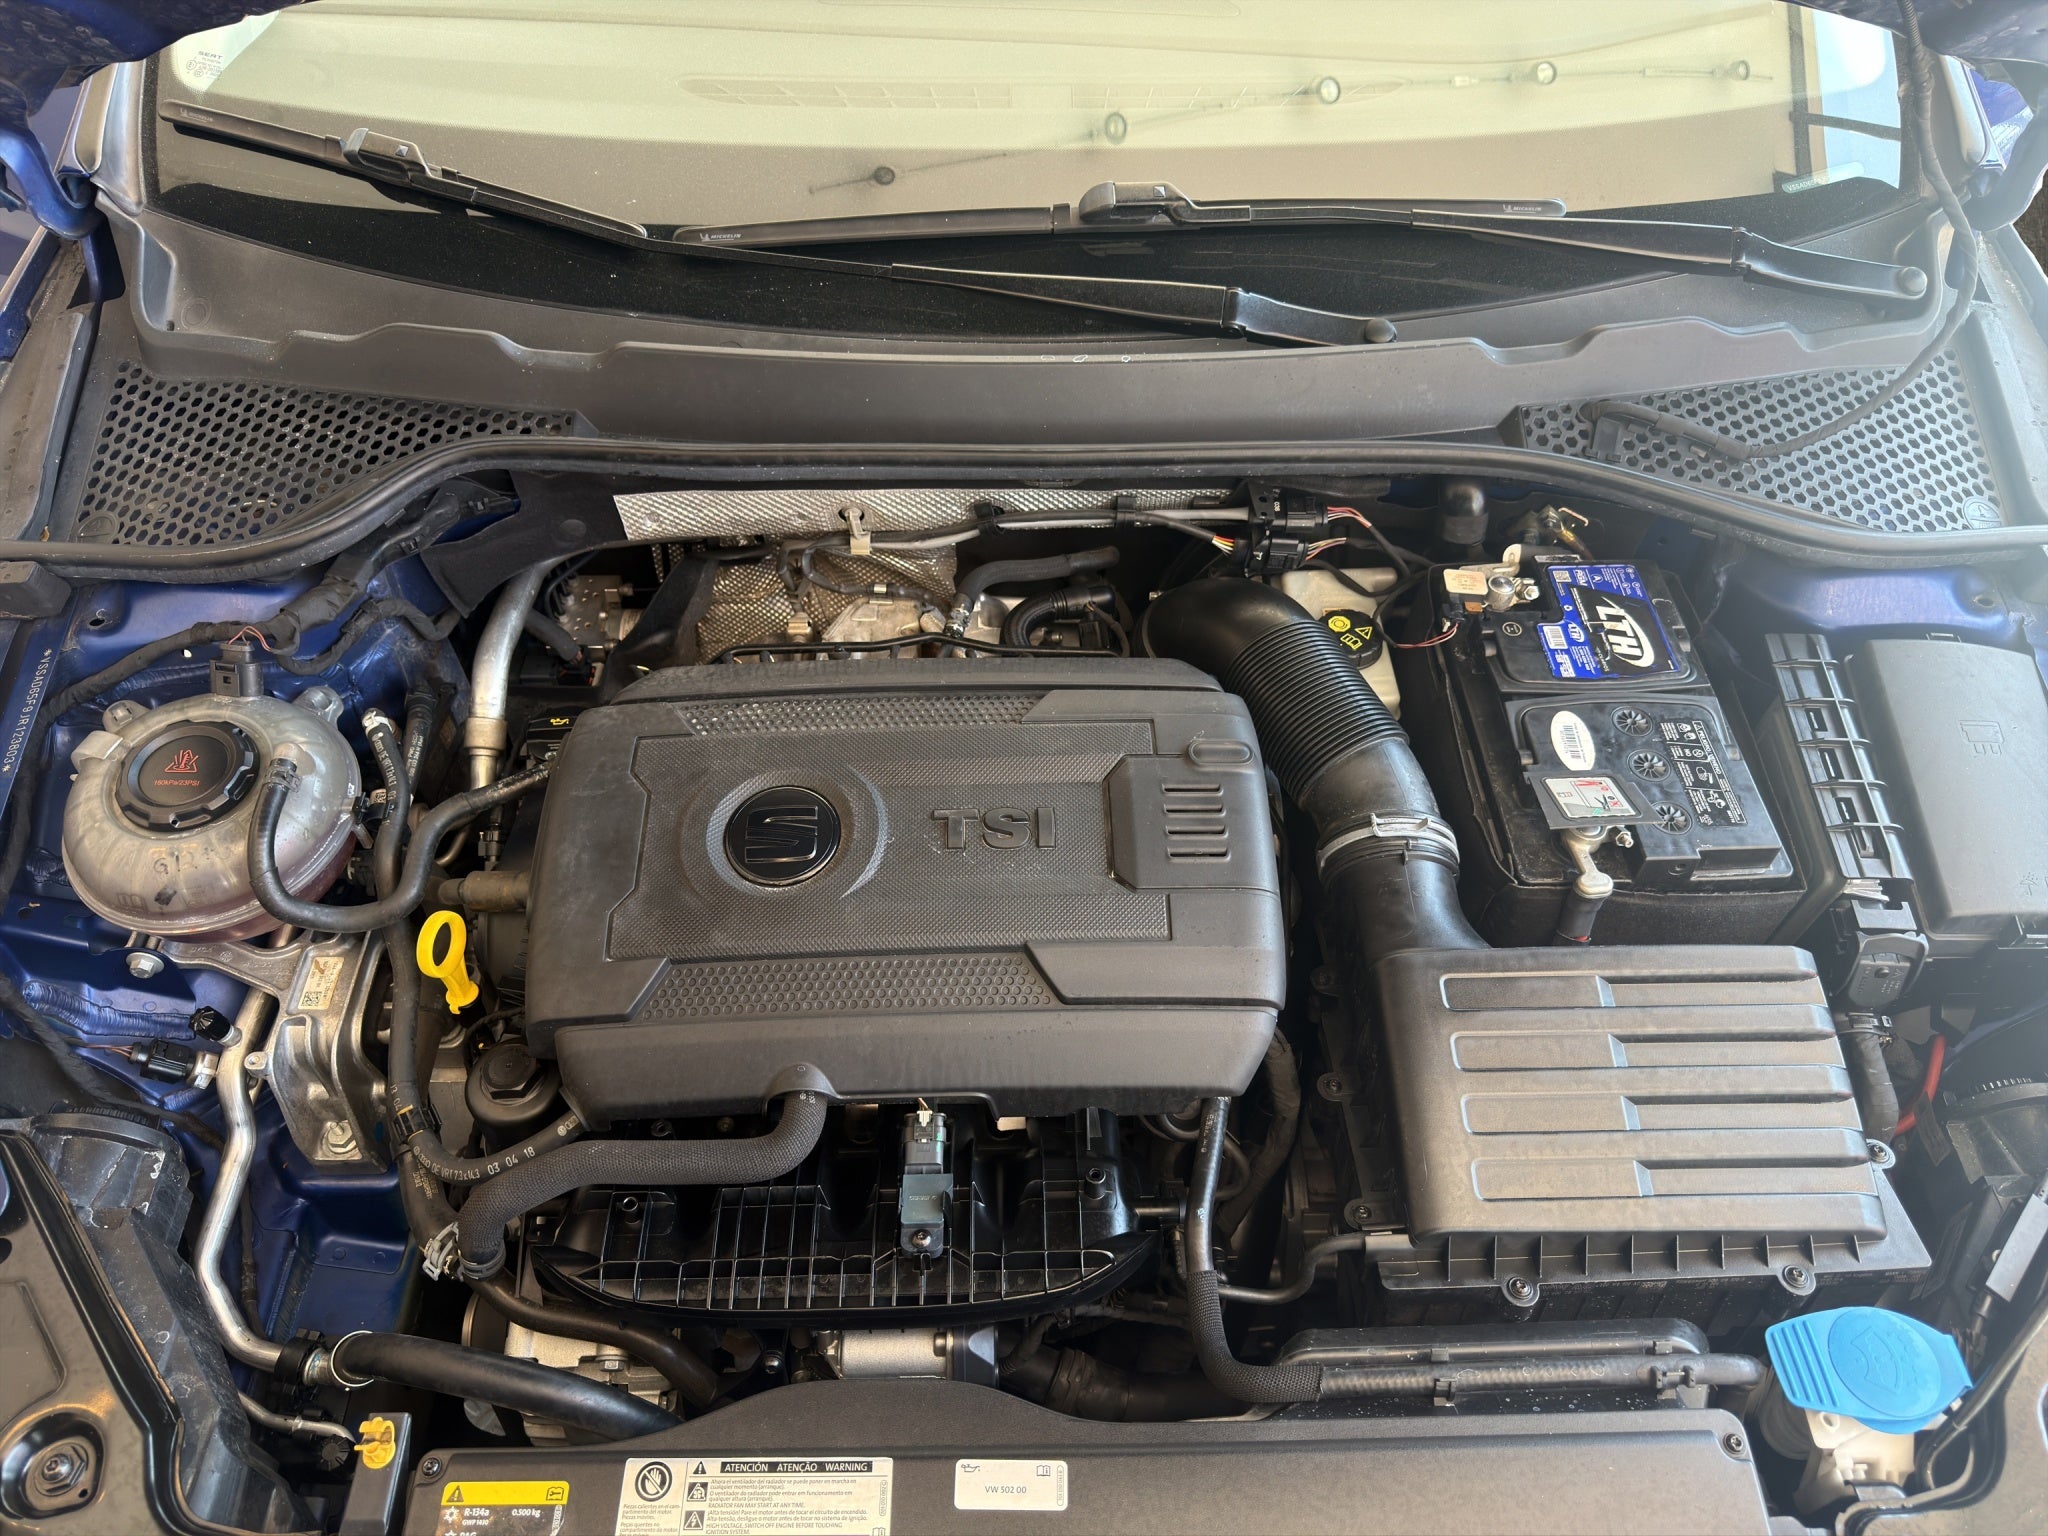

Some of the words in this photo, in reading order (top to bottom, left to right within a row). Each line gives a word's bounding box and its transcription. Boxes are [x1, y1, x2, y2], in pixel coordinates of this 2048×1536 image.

[1595, 605, 1643, 658] LTH
[932, 807, 1056, 851] TSI
[487, 1161, 501, 1175] 03
[505, 1154, 519, 1167] 04
[523, 1146, 536, 1159] 18
[724, 1461, 768, 1472] ATENCIÓN
[777, 1461, 818, 1473] ATENÇÃO
[825, 1462, 868, 1472] WARNING
[464, 1508, 490, 1516] R-134a
[512, 1508, 531, 1516] 0.500
[532, 1508, 541, 1518] kg
